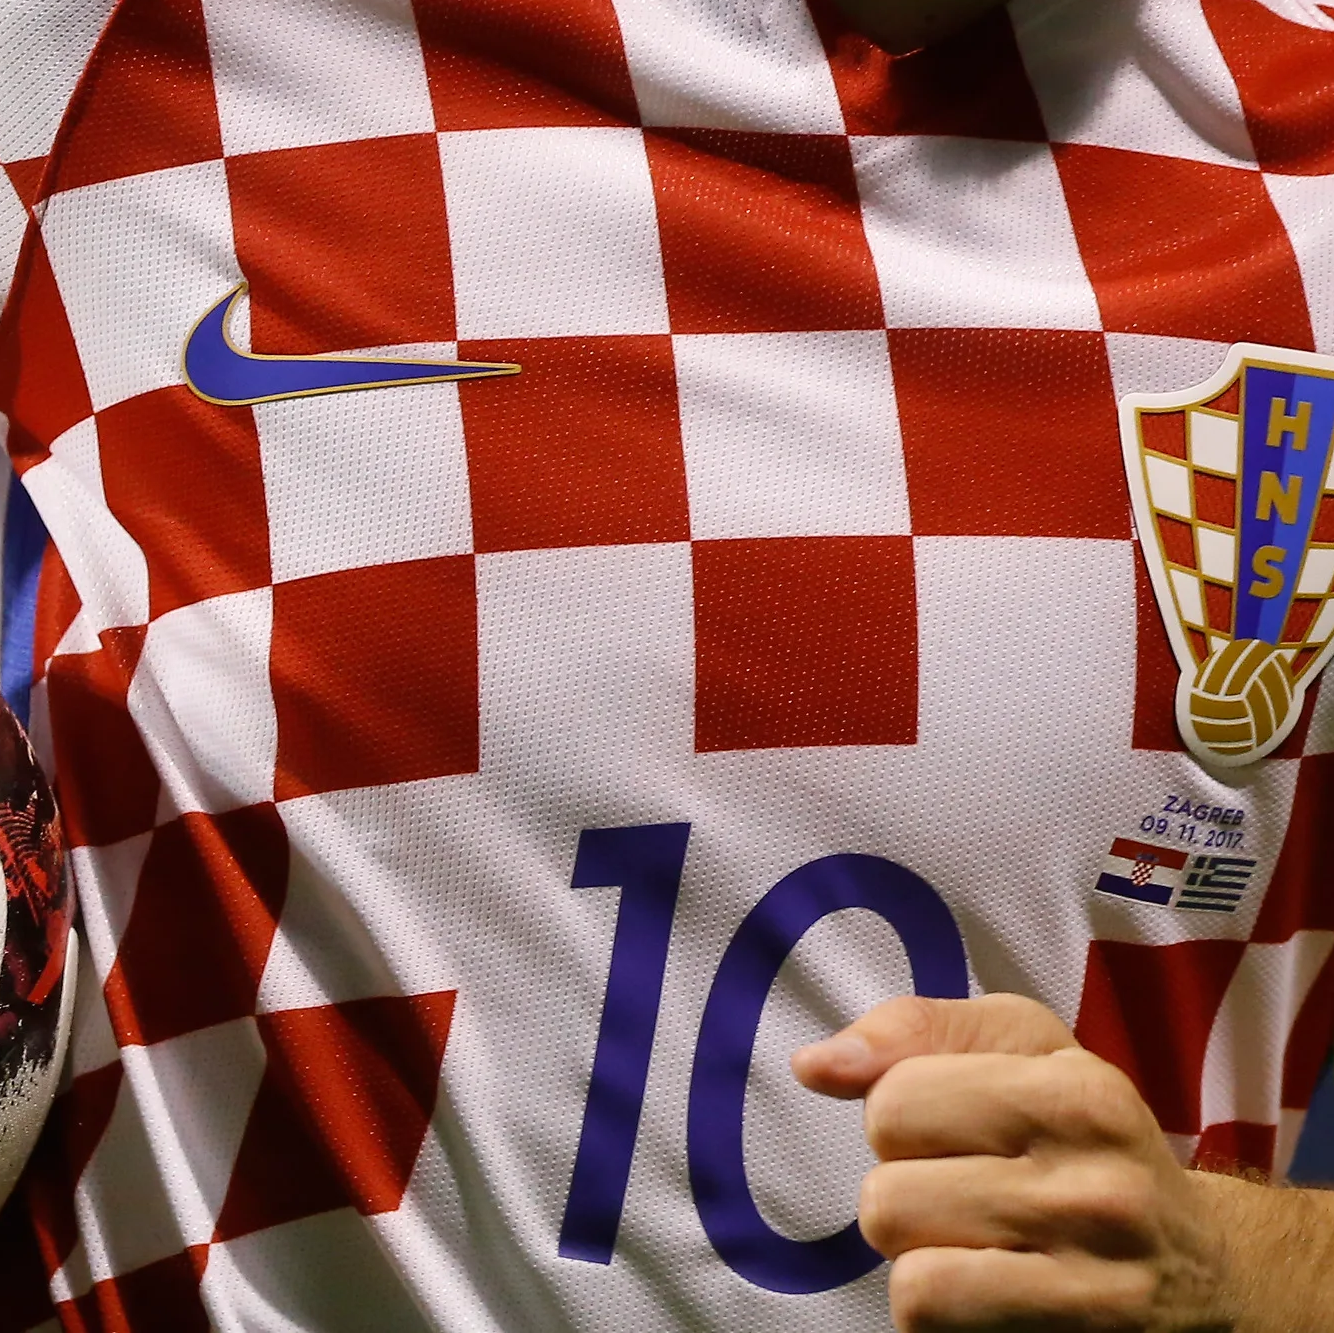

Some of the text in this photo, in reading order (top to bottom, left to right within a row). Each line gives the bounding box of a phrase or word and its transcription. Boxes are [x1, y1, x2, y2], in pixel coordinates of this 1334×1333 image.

[1248, 397, 1313, 599] HNS
[1163, 795, 1244, 826] ZAGREB
[558, 822, 969, 1294] 10
